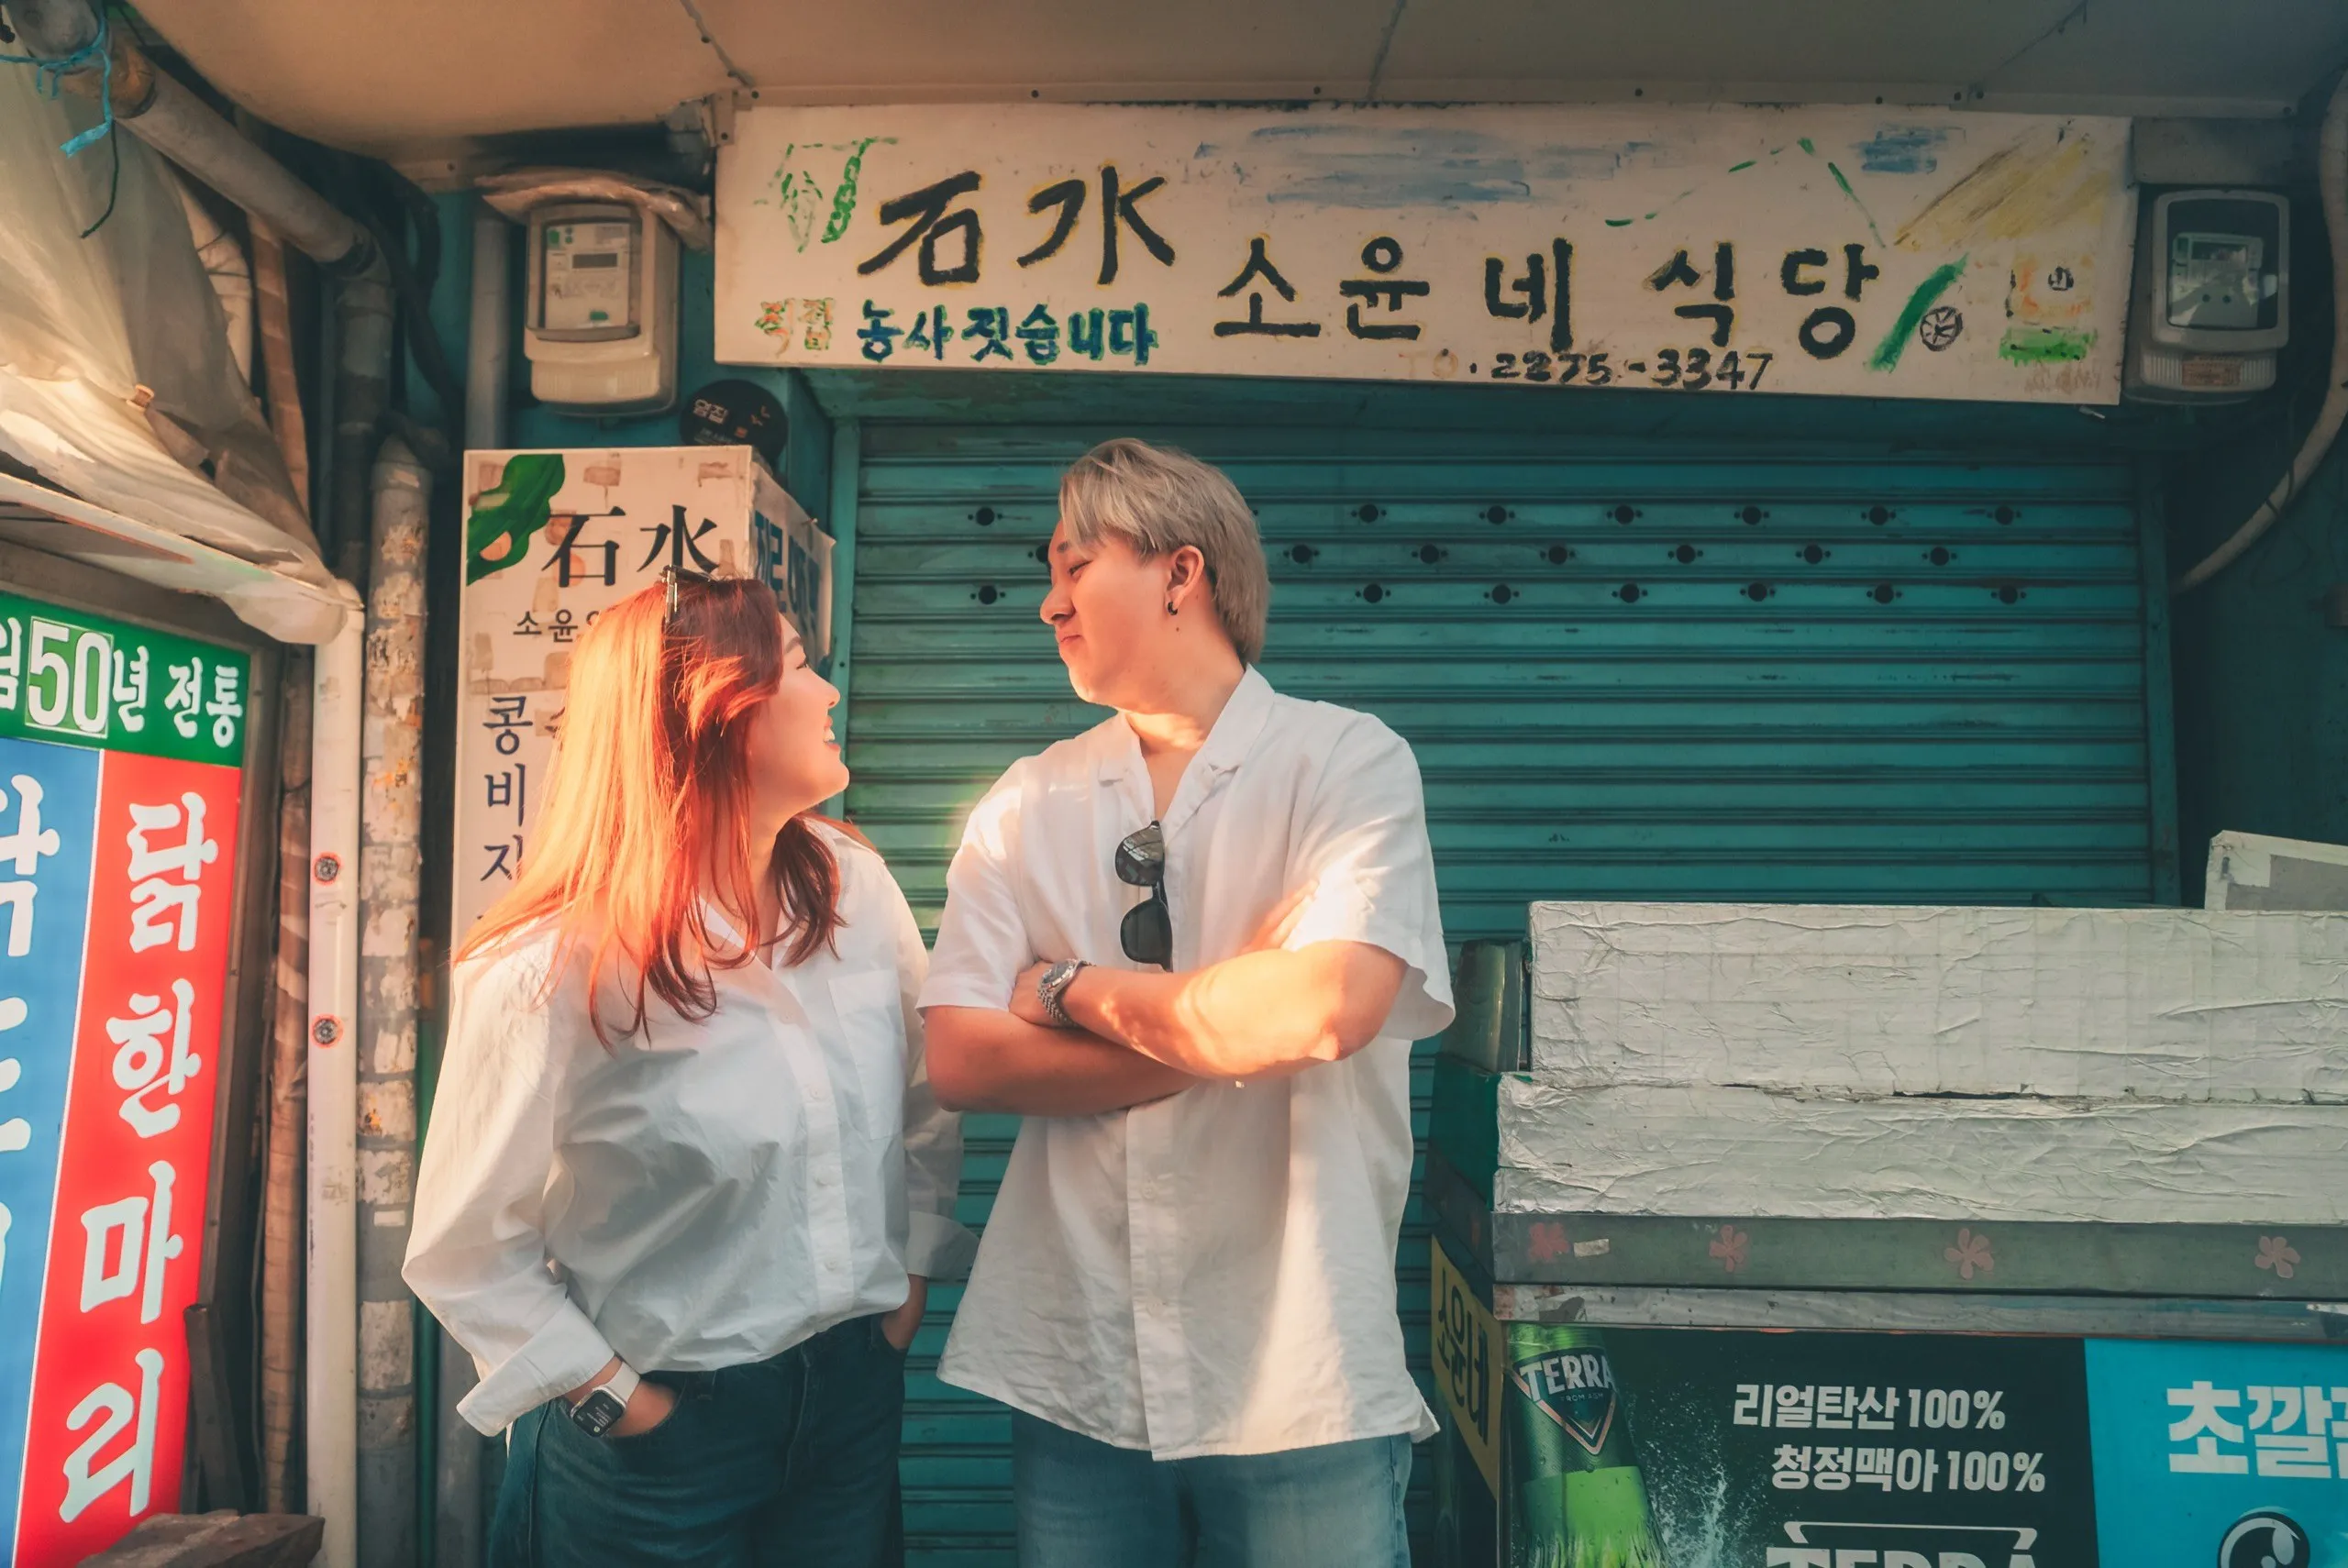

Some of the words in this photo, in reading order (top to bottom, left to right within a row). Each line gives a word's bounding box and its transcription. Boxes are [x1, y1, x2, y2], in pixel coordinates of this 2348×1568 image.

[858, 165, 1175, 286] 石水
[164, 657, 243, 747] 전통
[1519, 1354, 1618, 1401] TERRA
[1733, 1384, 1899, 1430] 리얼탄산
[1909, 1388, 2005, 1430] 100%
[1772, 1444, 1939, 1492] 청정맥아
[1947, 1451, 2045, 1493] 100%
